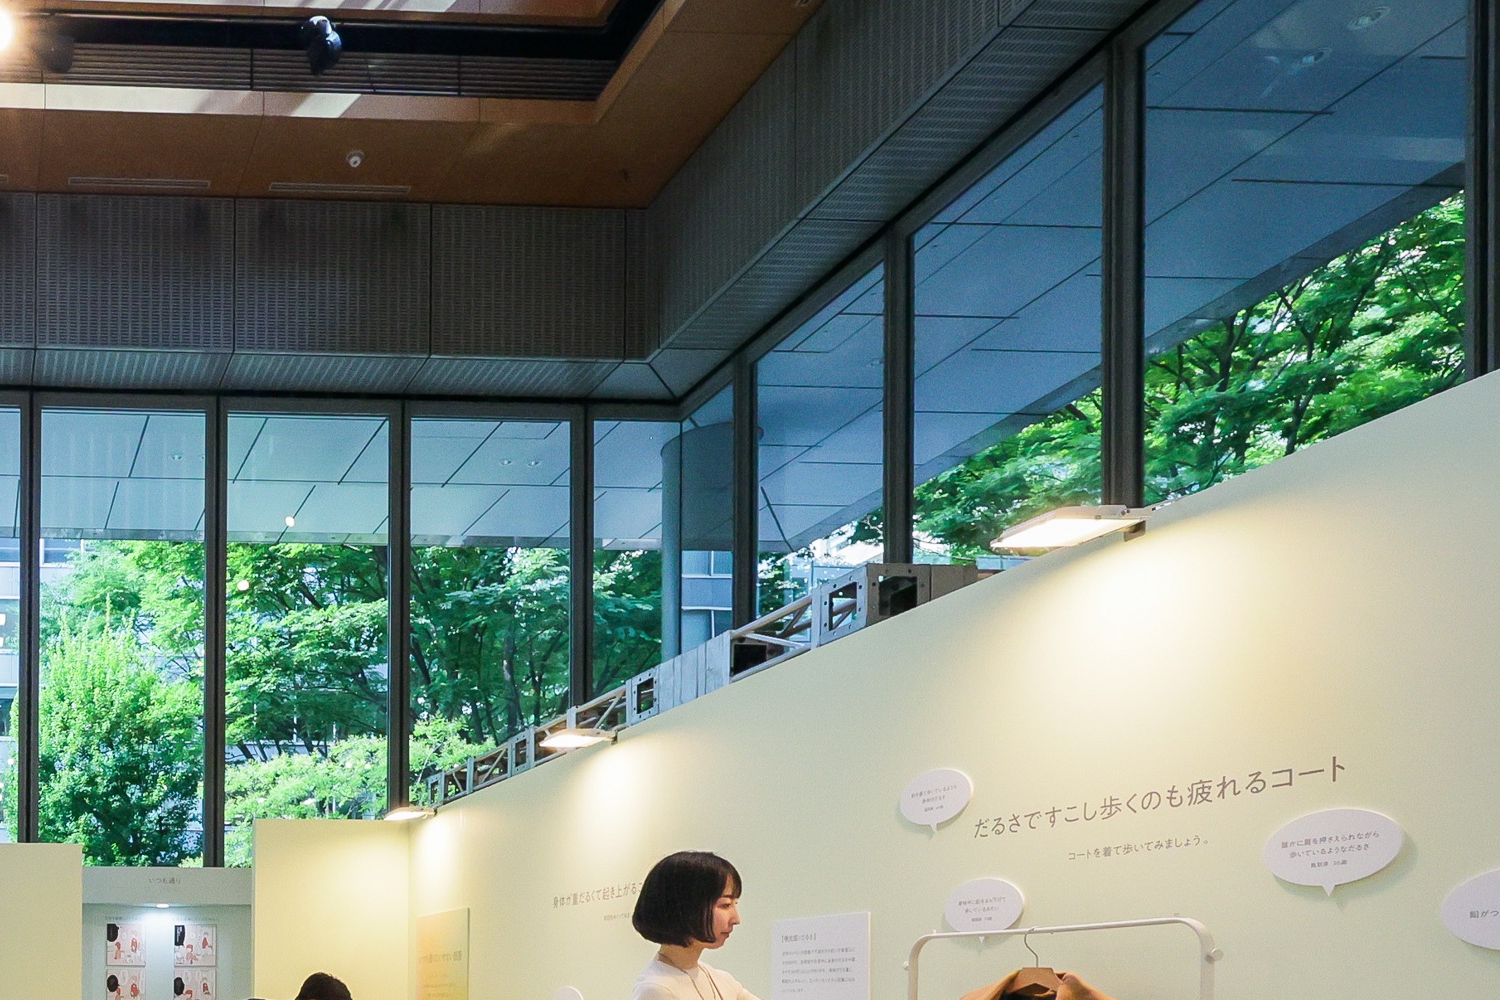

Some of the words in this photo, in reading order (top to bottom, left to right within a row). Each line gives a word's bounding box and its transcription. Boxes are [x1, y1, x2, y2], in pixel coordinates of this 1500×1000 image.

[974, 756, 1345, 838] だるさですこし歩くのも疲れるコート
[1068, 835, 1209, 861] コートを着て歩いてみましょう。
